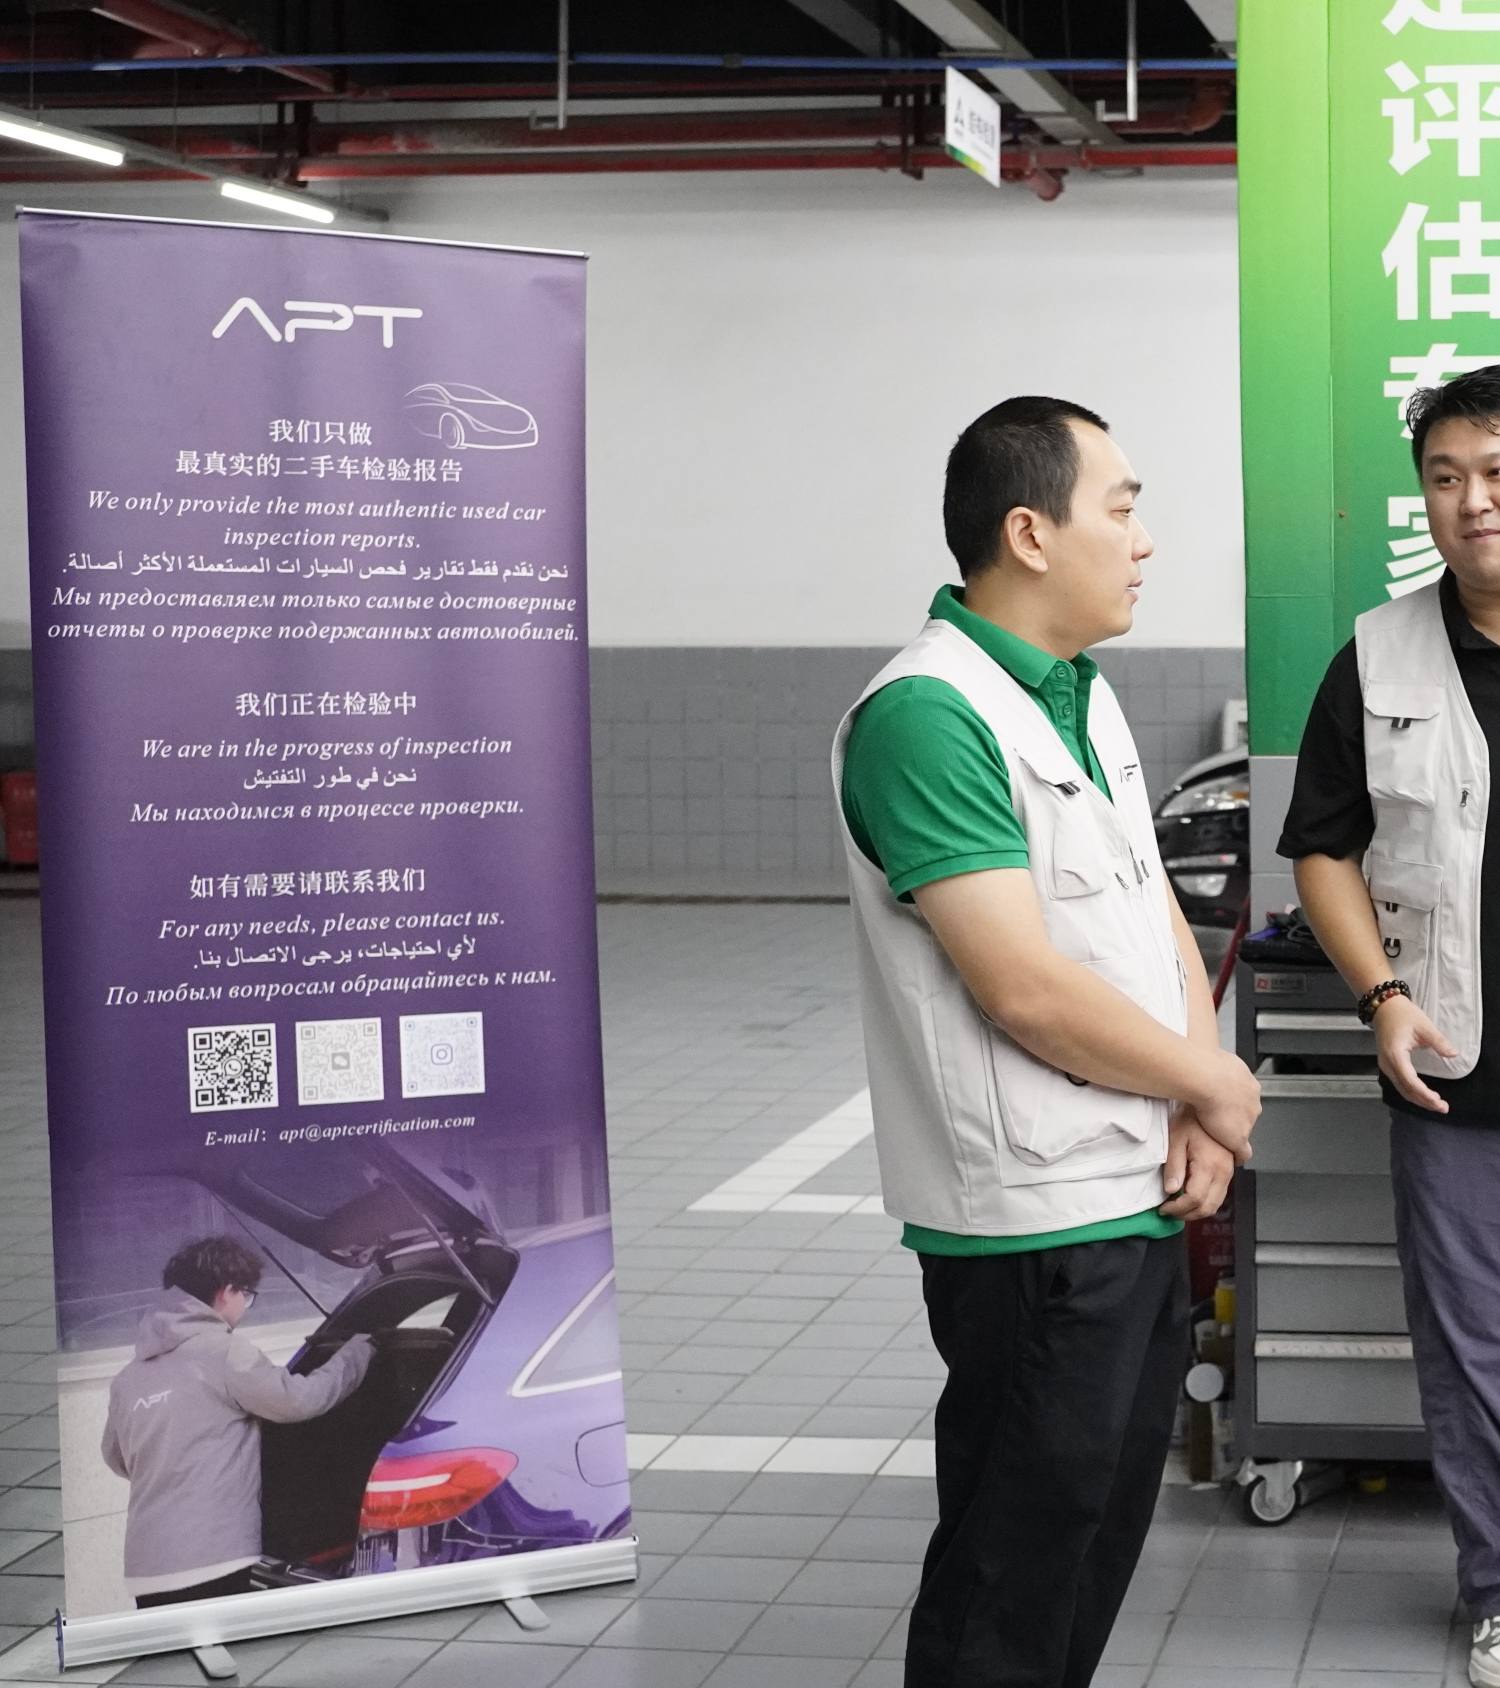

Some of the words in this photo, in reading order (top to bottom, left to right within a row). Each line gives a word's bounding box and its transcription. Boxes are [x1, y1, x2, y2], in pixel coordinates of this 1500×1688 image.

[211, 296, 424, 349] APT
[268, 418, 373, 446] 我们只做
[175, 449, 463, 483] 最真实的二手车检验报告
[89, 490, 120, 510] We
[124, 491, 174, 516] only
[176, 495, 261, 517] provide
[266, 495, 300, 515] the
[304, 501, 355, 516] most
[358, 499, 457, 519] authentic
[459, 502, 509, 521] used
[512, 507, 547, 523] car
[223, 527, 336, 551] inspection
[340, 533, 420, 552] reports.
[51, 586, 92, 606] Мы
[98, 587, 276, 611] предоставляем
[281, 594, 361, 609] только
[365, 595, 435, 610] самые
[439, 591, 577, 615] достоверные
[47, 623, 146, 638] отчеты
[151, 624, 165, 638] о
[170, 624, 273, 644] проверке
[277, 620, 433, 644] подержанных
[436, 621, 579, 641] автомобилей.
[235, 690, 417, 717] 我们正在检验中
[143, 739, 173, 759] We
[177, 743, 213, 759] are
[218, 739, 239, 758] in
[244, 737, 278, 758] the
[280, 742, 375, 762] progress
[379, 736, 405, 760] of
[404, 736, 512, 760] inspection
[129, 802, 169, 823] Мы
[174, 801, 295, 822] находимся
[300, 804, 312, 819] в
[317, 802, 415, 823] процессе
[419, 800, 524, 821] проверки.
[189, 867, 425, 900] 如有需要请联系我们
[158, 919, 200, 940] For
[204, 922, 244, 941] any
[248, 913, 316, 936] needs,
[321, 912, 391, 938] please
[394, 911, 473, 930] contact
[476, 911, 505, 926] us.
[104, 985, 139, 1006] По
[143, 982, 223, 1004] любым
[228, 980, 336, 1002] вопросам
[340, 970, 490, 997] обращайтесь
[494, 971, 507, 986] к
[511, 969, 557, 985] нам.
[278, 1116, 476, 1144] apt@aptcertification.com
[132, 1389, 172, 1411] APT
